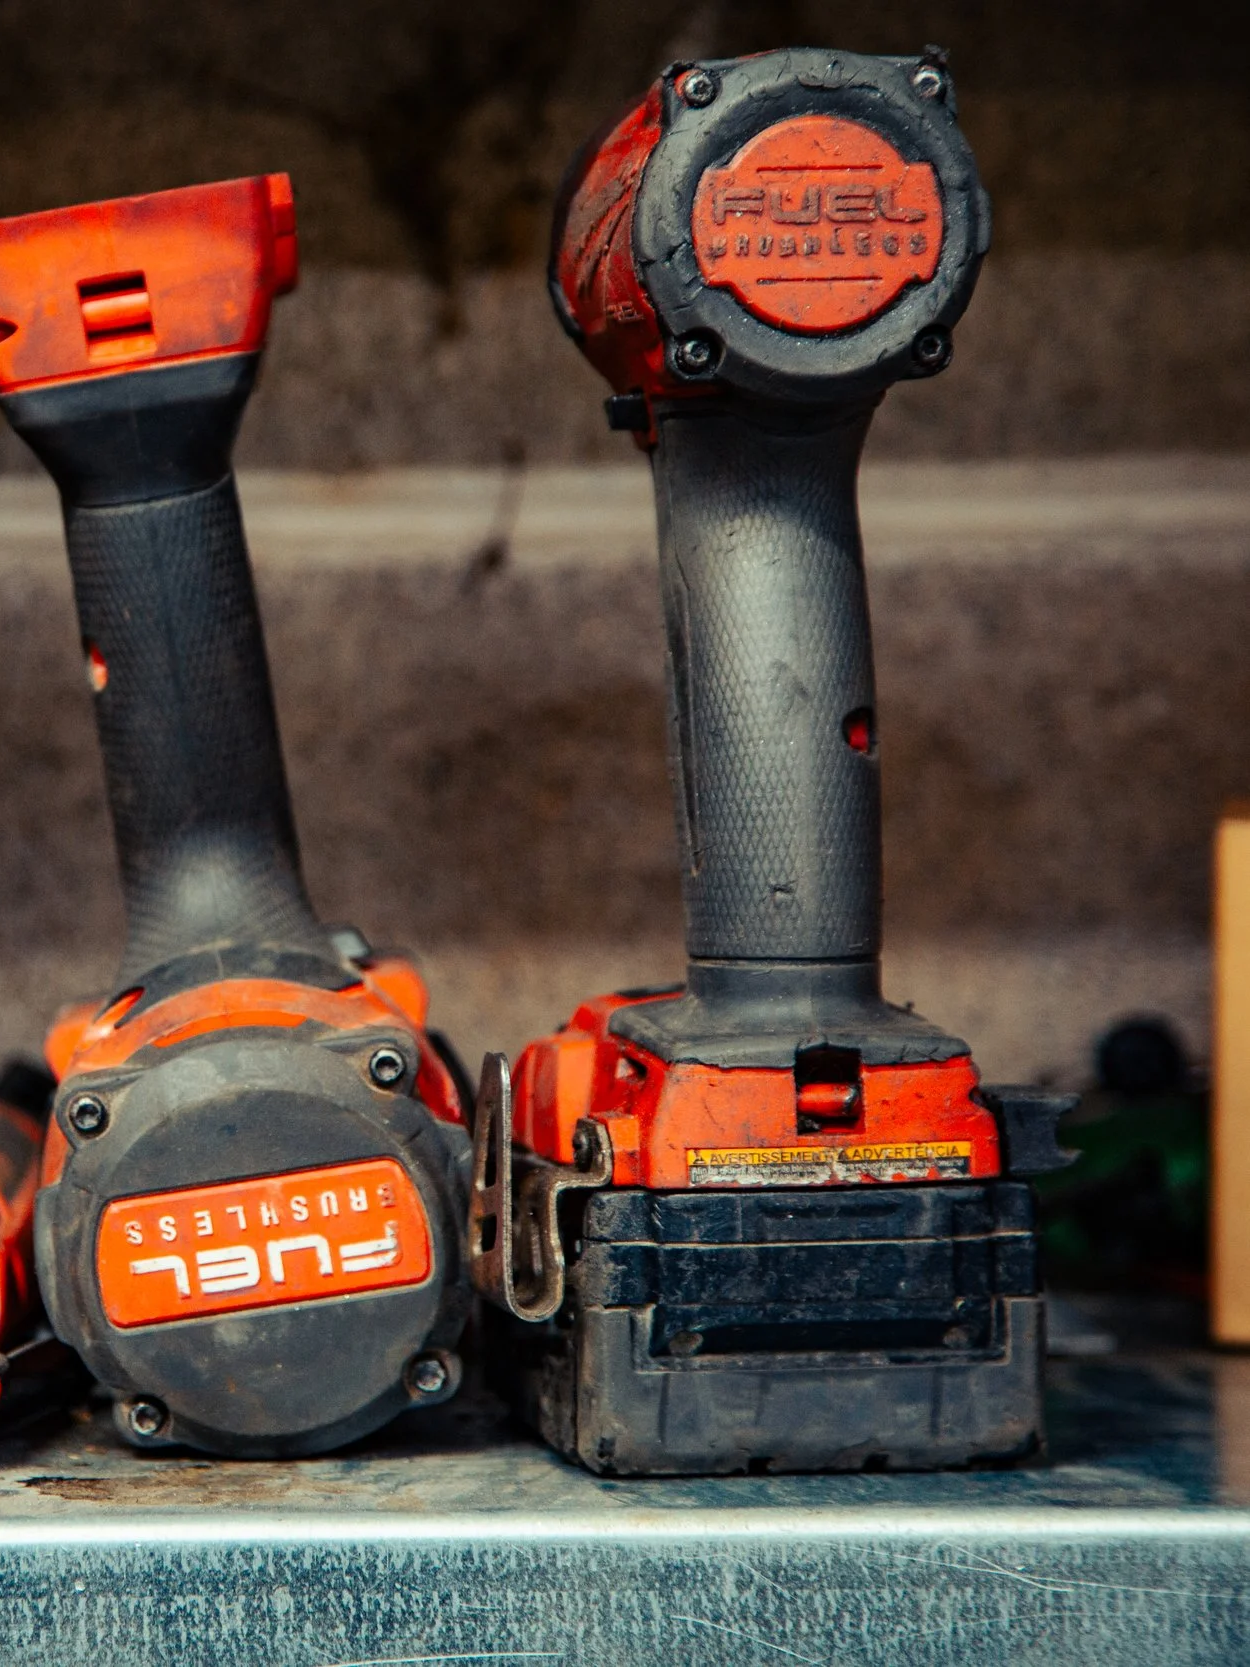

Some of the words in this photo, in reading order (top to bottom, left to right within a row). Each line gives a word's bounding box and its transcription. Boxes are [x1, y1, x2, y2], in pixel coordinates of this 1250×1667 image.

[713, 184, 927, 226] FUEL
[124, 1183, 397, 1246] BRUSHLESS
[129, 1219, 400, 1300] FUEL
